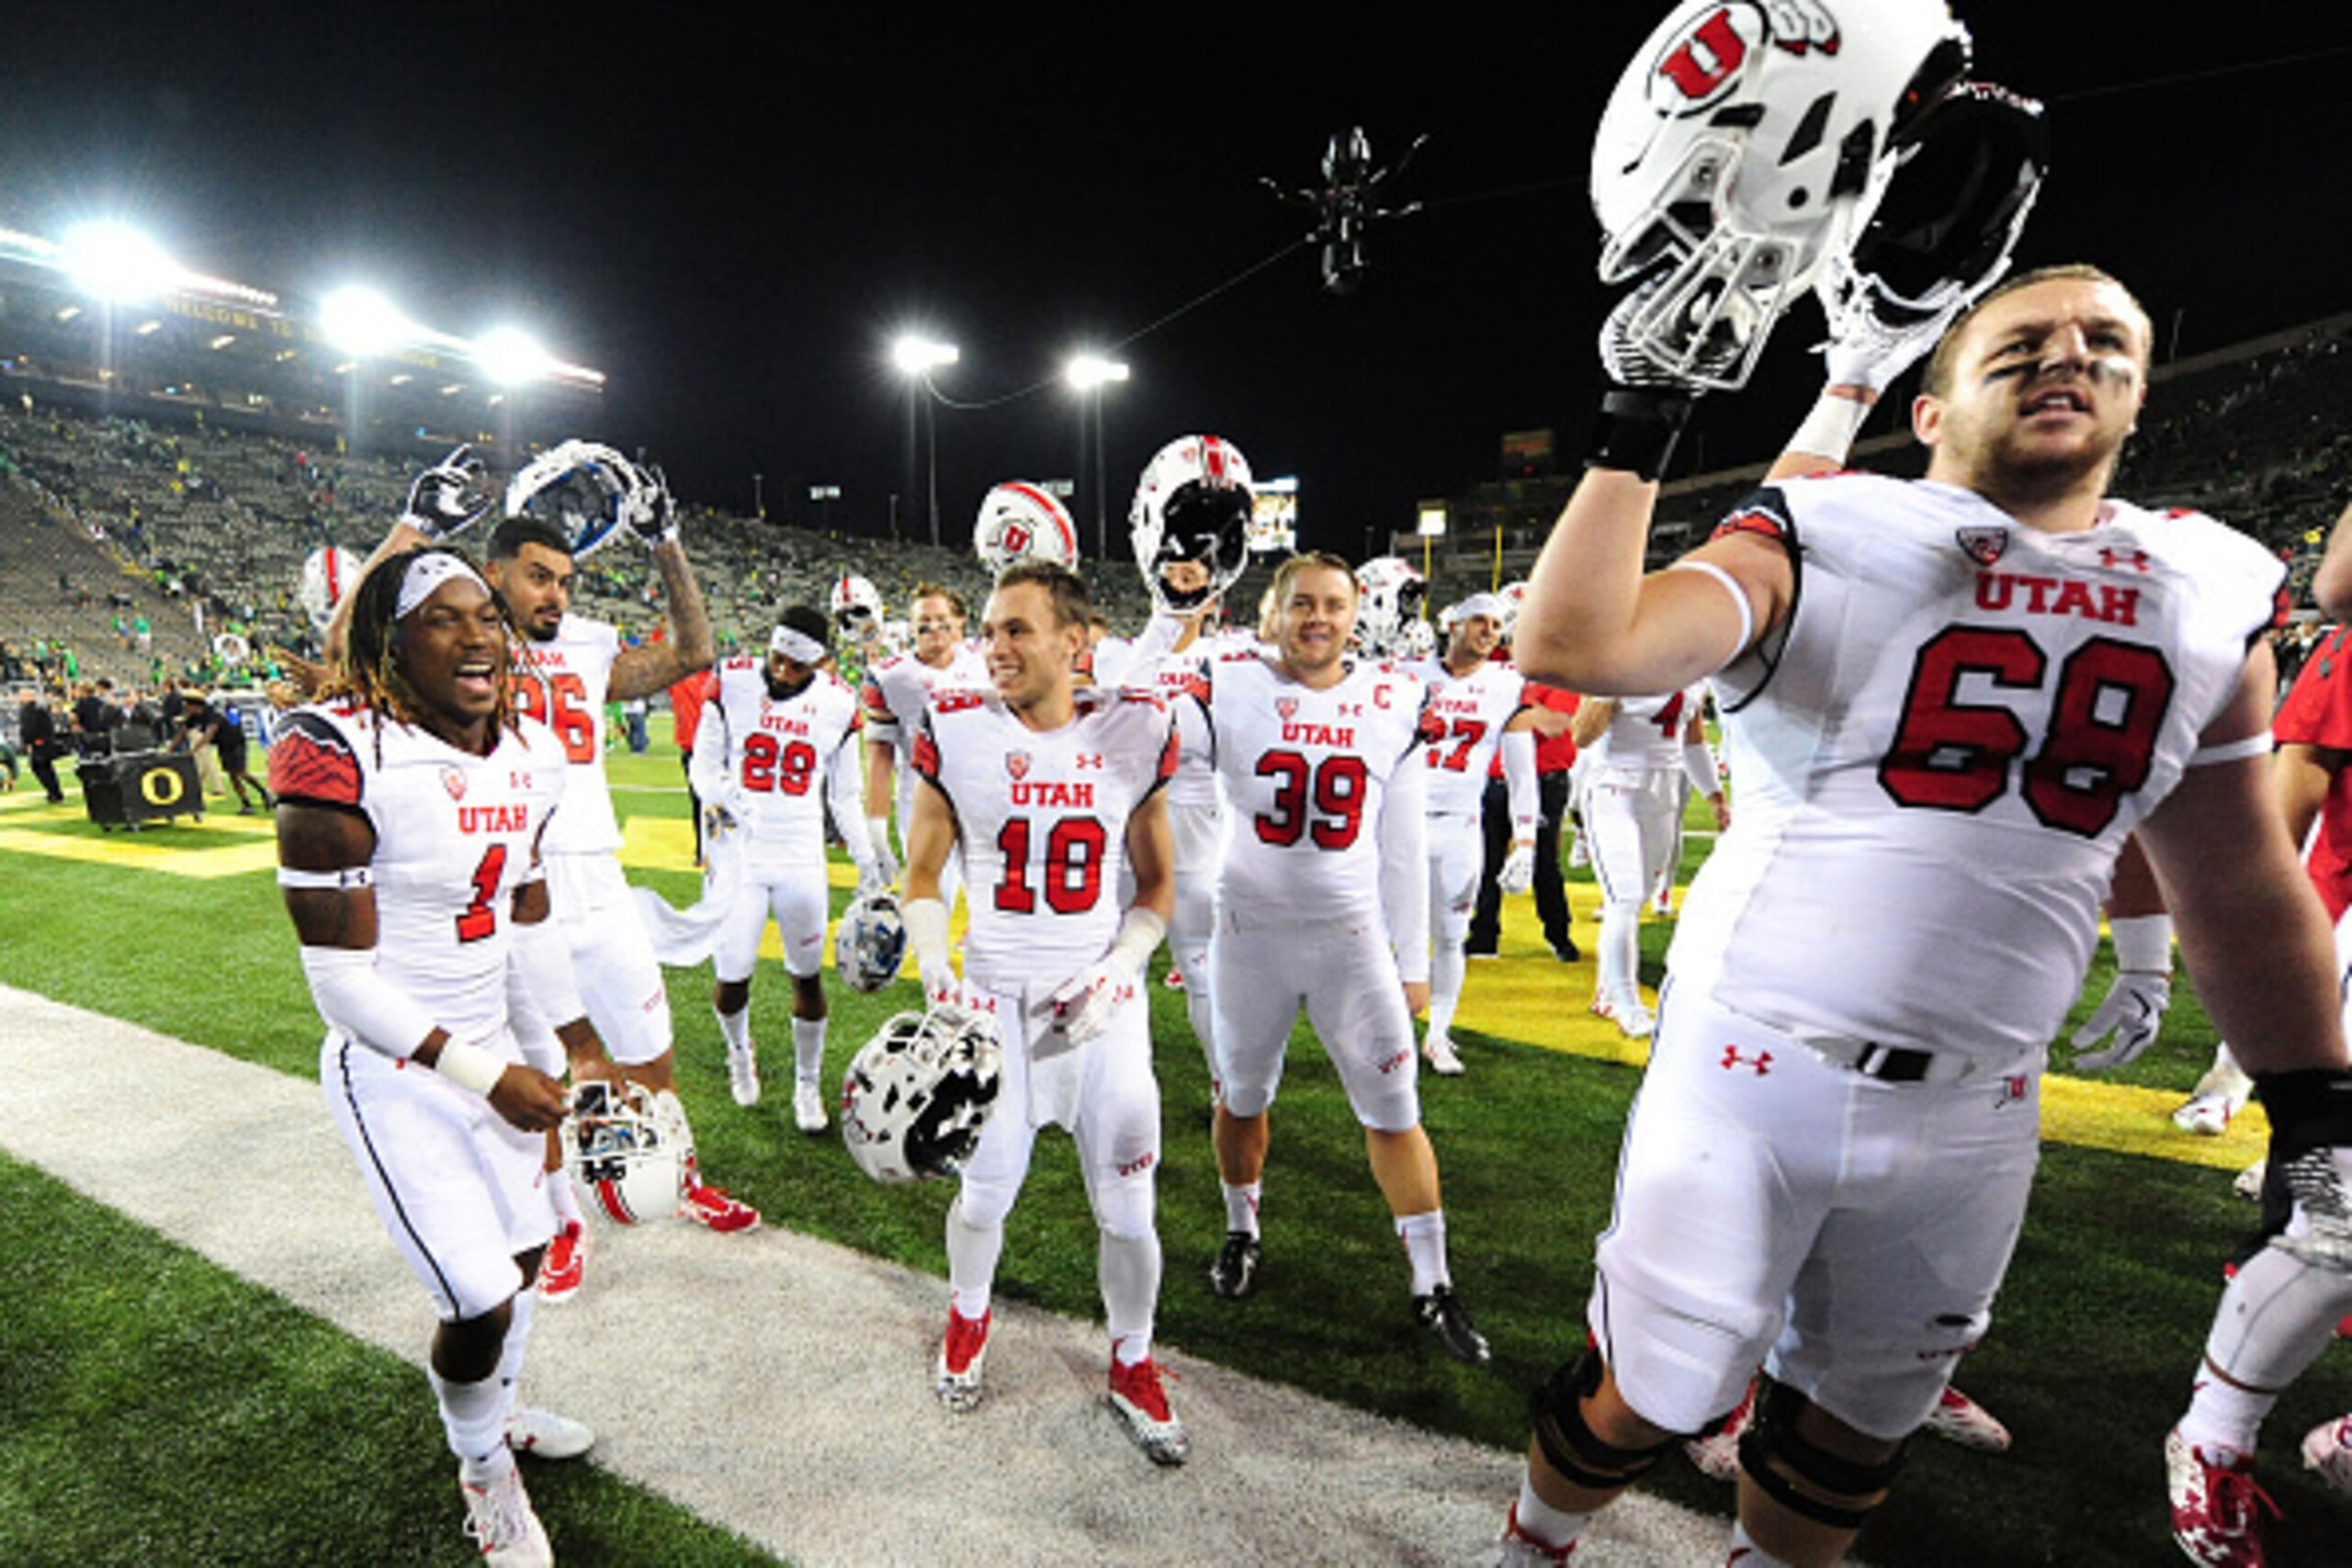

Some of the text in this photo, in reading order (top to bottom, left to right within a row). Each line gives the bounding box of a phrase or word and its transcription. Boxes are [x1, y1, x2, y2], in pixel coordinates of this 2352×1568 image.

[1658, 7, 1747, 99] U
[1974, 571, 2140, 626] UTAH
[1373, 684, 1392, 709] C
[760, 715, 809, 737] UTAH
[1282, 723, 1355, 748] UTAH
[1877, 622, 2177, 840] 68
[141, 767, 183, 805] O
[742, 732, 816, 796] 29
[458, 802, 528, 834] UTAH
[1011, 783, 1093, 807] UTAH
[1254, 749, 1368, 850] 39
[994, 815, 1107, 915] 18
[456, 843, 507, 944] 1
